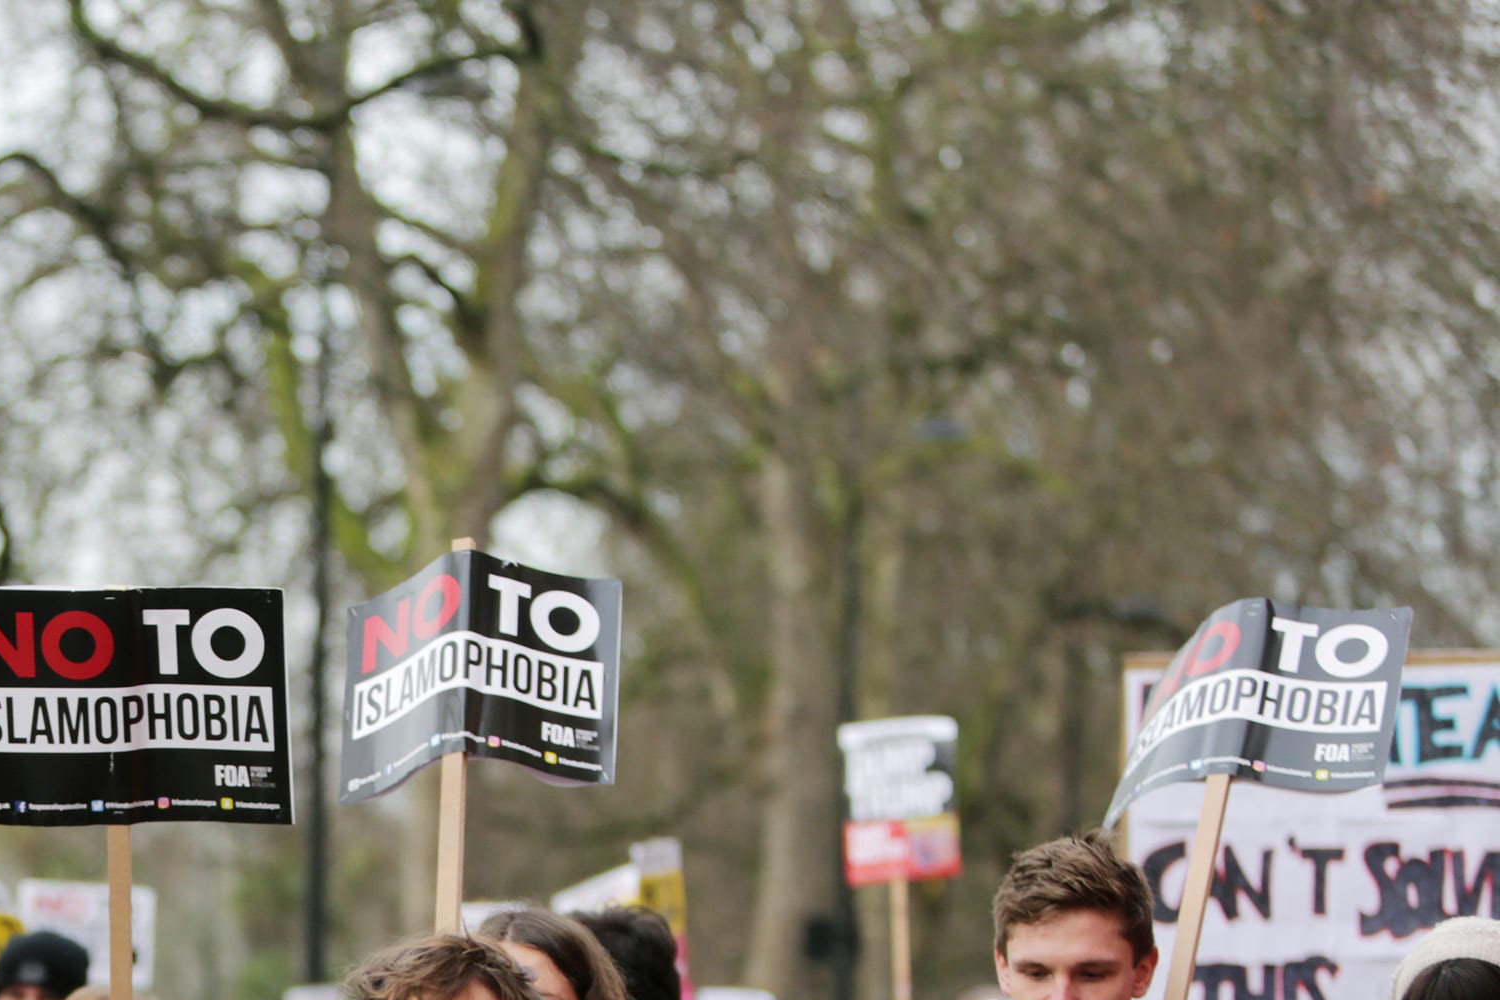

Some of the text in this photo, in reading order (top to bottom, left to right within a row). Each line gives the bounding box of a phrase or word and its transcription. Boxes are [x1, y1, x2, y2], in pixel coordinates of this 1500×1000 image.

[142, 607, 266, 679] TO
[360, 573, 601, 675] NO TO
[1271, 616, 1389, 679] TO
[355, 638, 597, 732] ISLAMOPHOBIA
[541, 721, 576, 748] FOA
[1314, 742, 1350, 763] FOA
[214, 765, 251, 788] FOA
